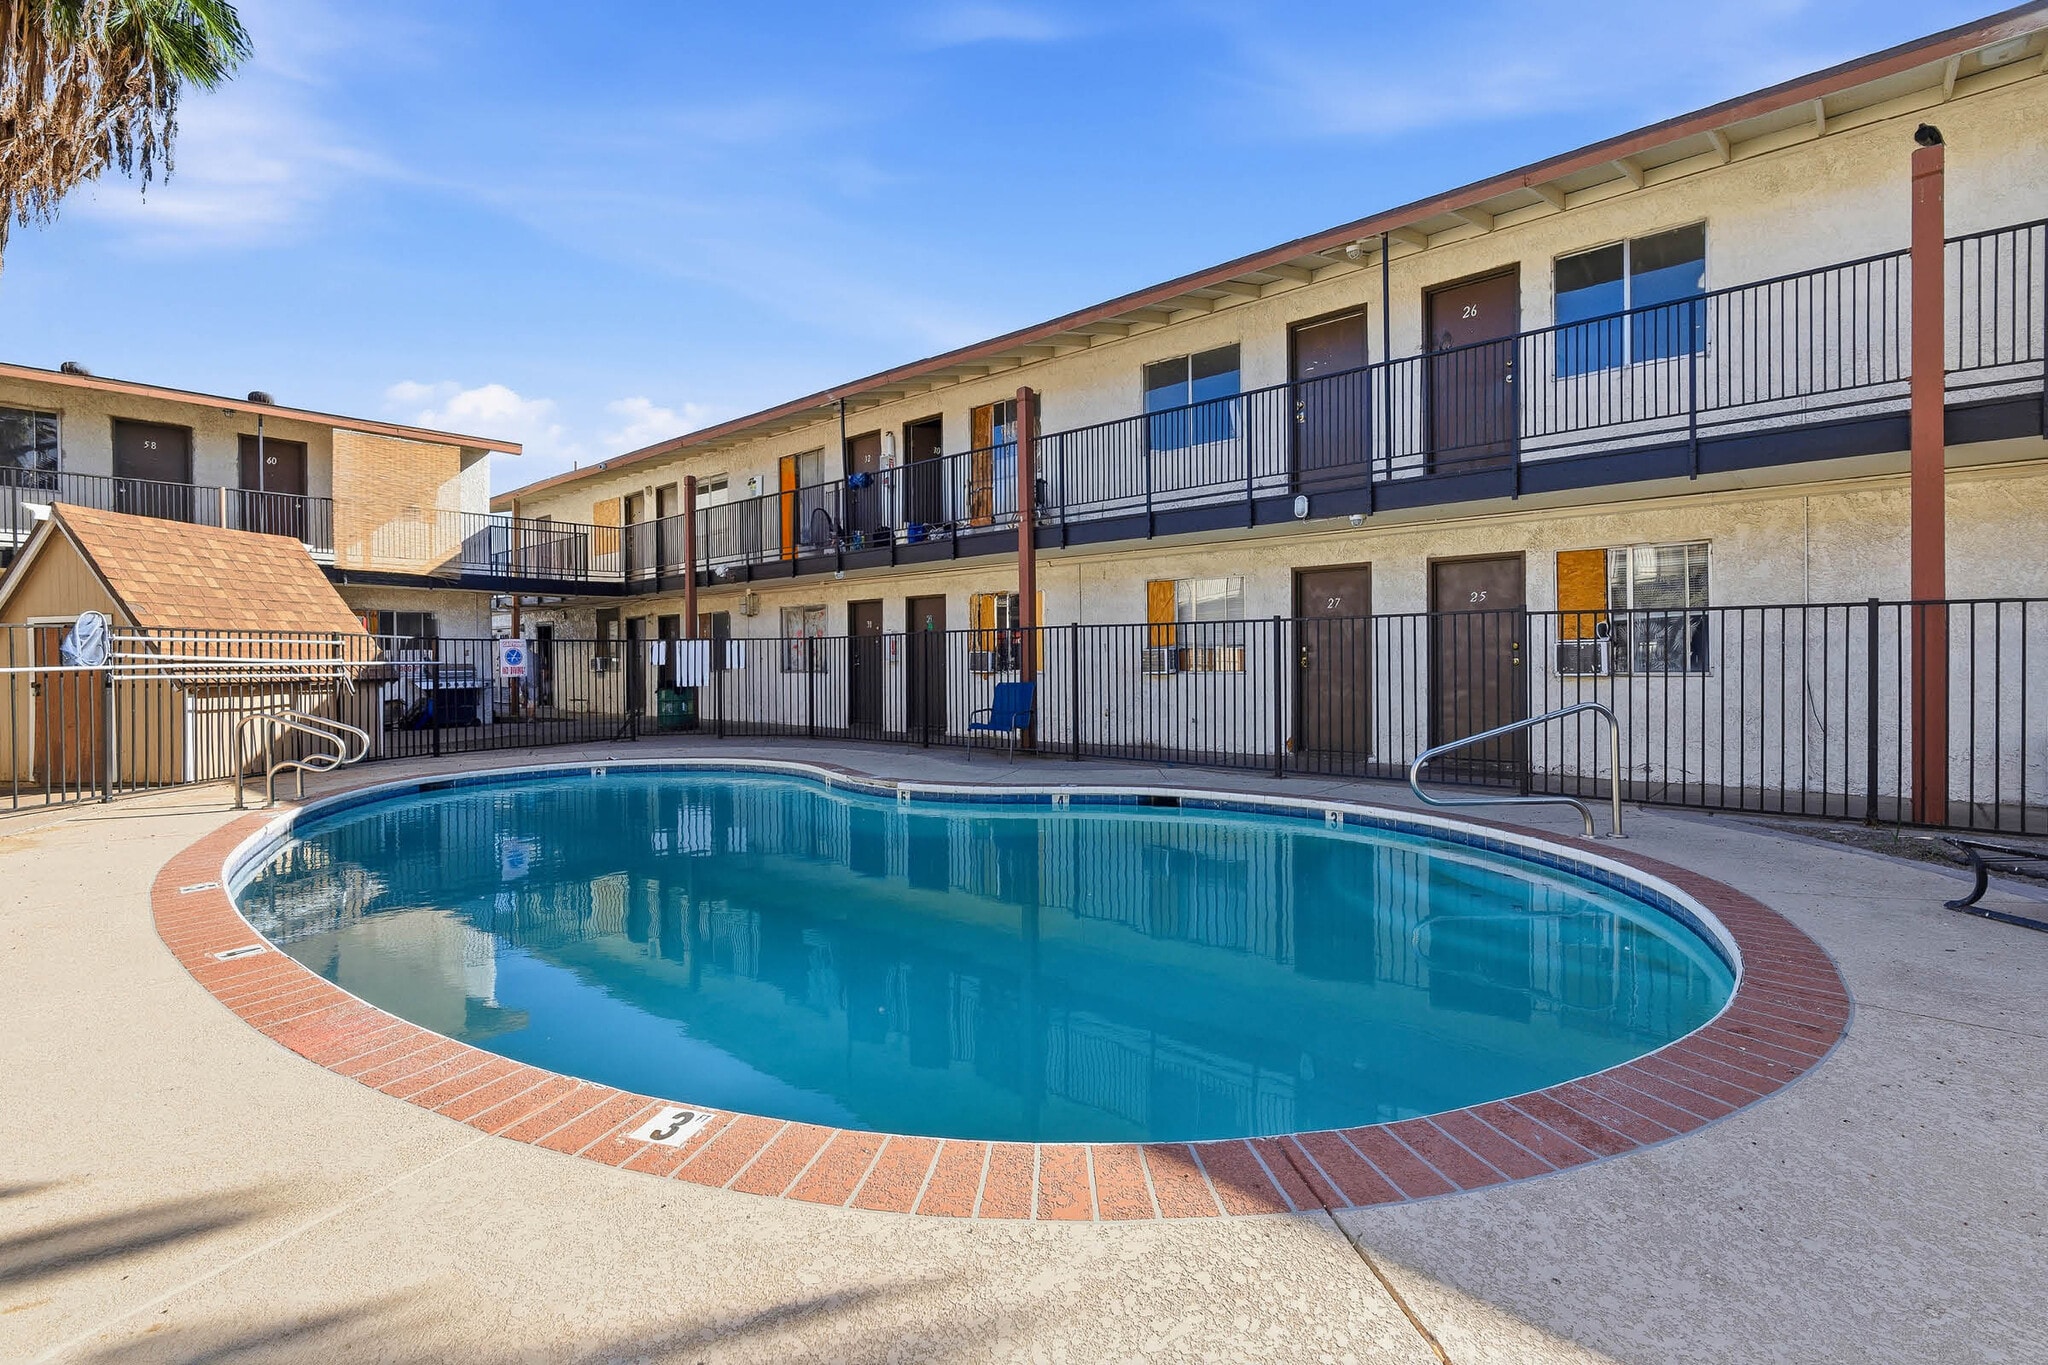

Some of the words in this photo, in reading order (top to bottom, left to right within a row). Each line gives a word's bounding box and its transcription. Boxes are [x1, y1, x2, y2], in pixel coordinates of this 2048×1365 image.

[1462, 304, 1477, 319] 26
[144, 440, 157, 450] 58
[266, 456, 278, 465] 60
[1470, 591, 1487, 602] 25
[1327, 597, 1341, 609] 27
[649, 1111, 695, 1141] 3
